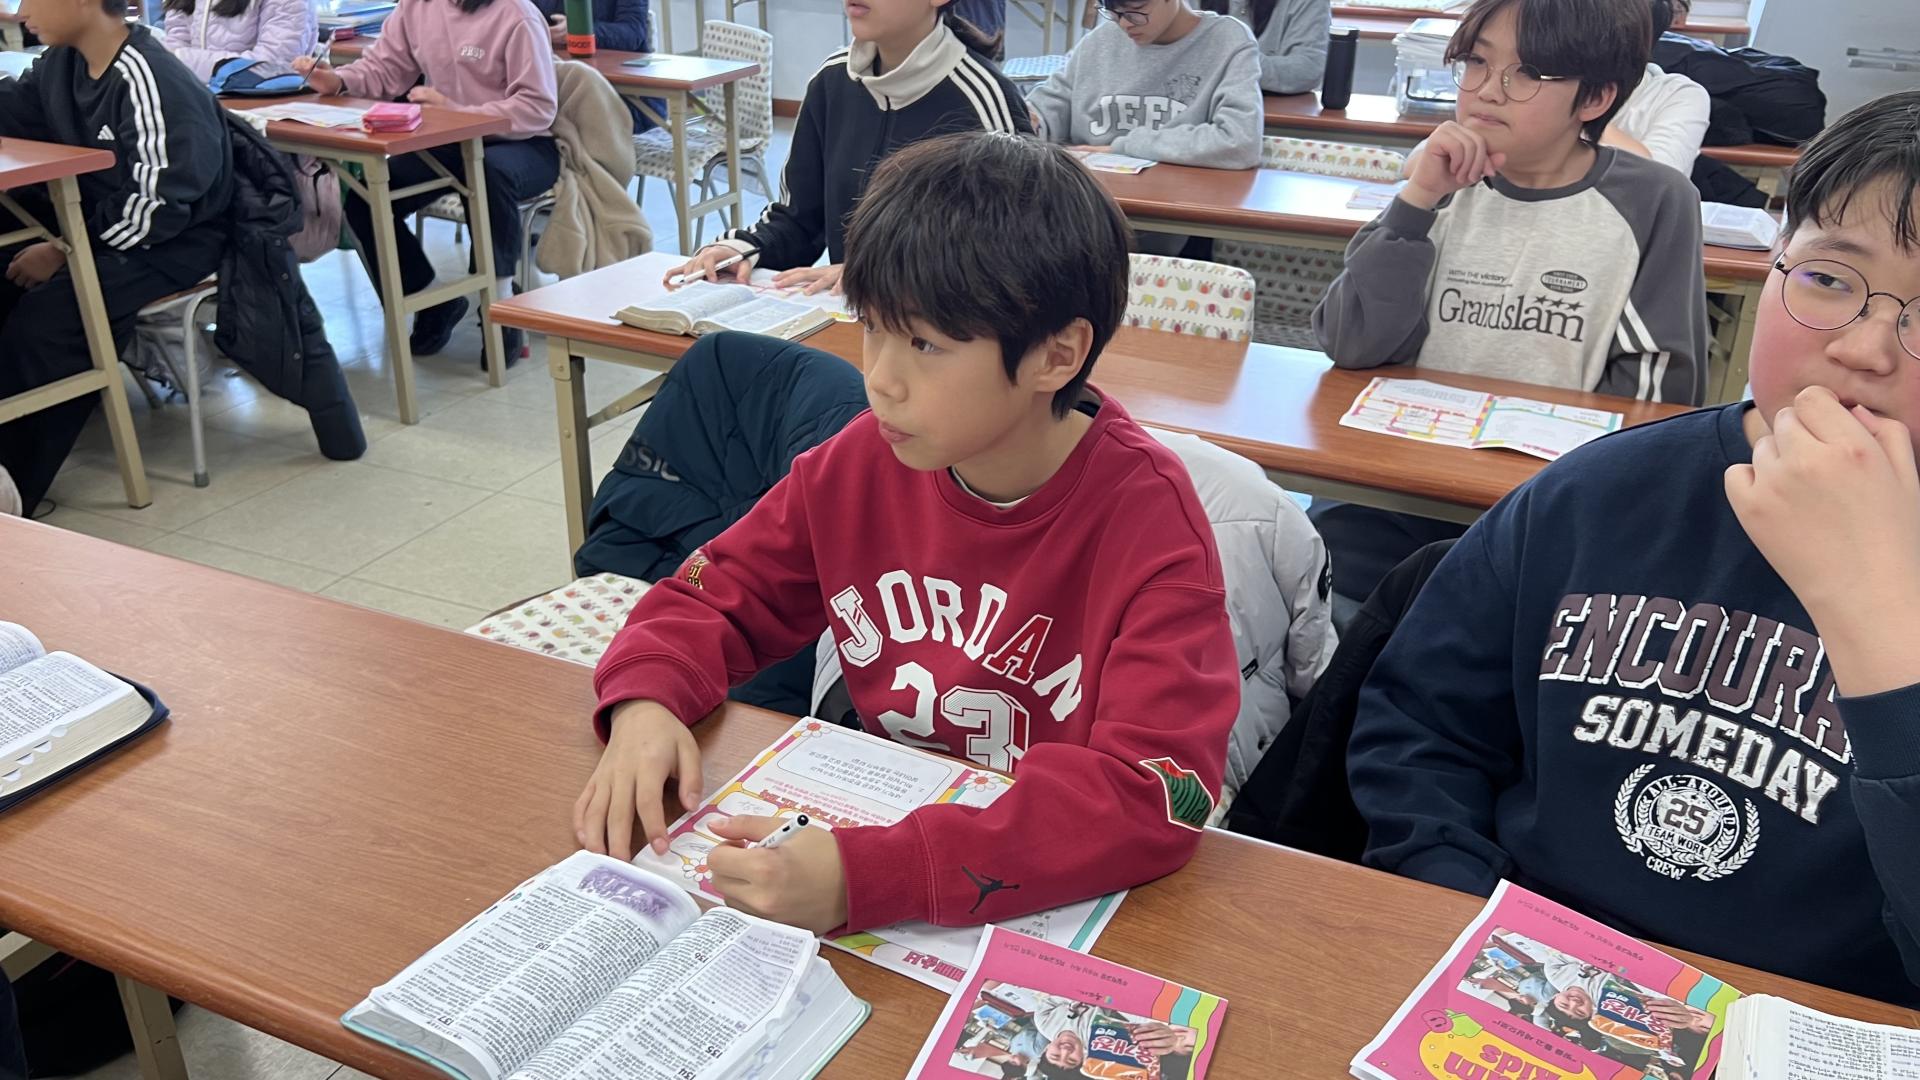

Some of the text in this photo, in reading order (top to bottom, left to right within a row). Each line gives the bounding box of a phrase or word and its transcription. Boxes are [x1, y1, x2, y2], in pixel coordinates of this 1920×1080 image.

[1438, 287, 1585, 343] Grandslam
[829, 568, 1084, 723] JORDAN
[876, 660, 1031, 773] 23
[1572, 694, 1841, 825] SOMEDAY
[1663, 797, 1710, 836] 25
[1648, 825, 1709, 857] TEAM WORK
[1646, 855, 1687, 881] CREW
[705, 1045, 723, 1059] 135
